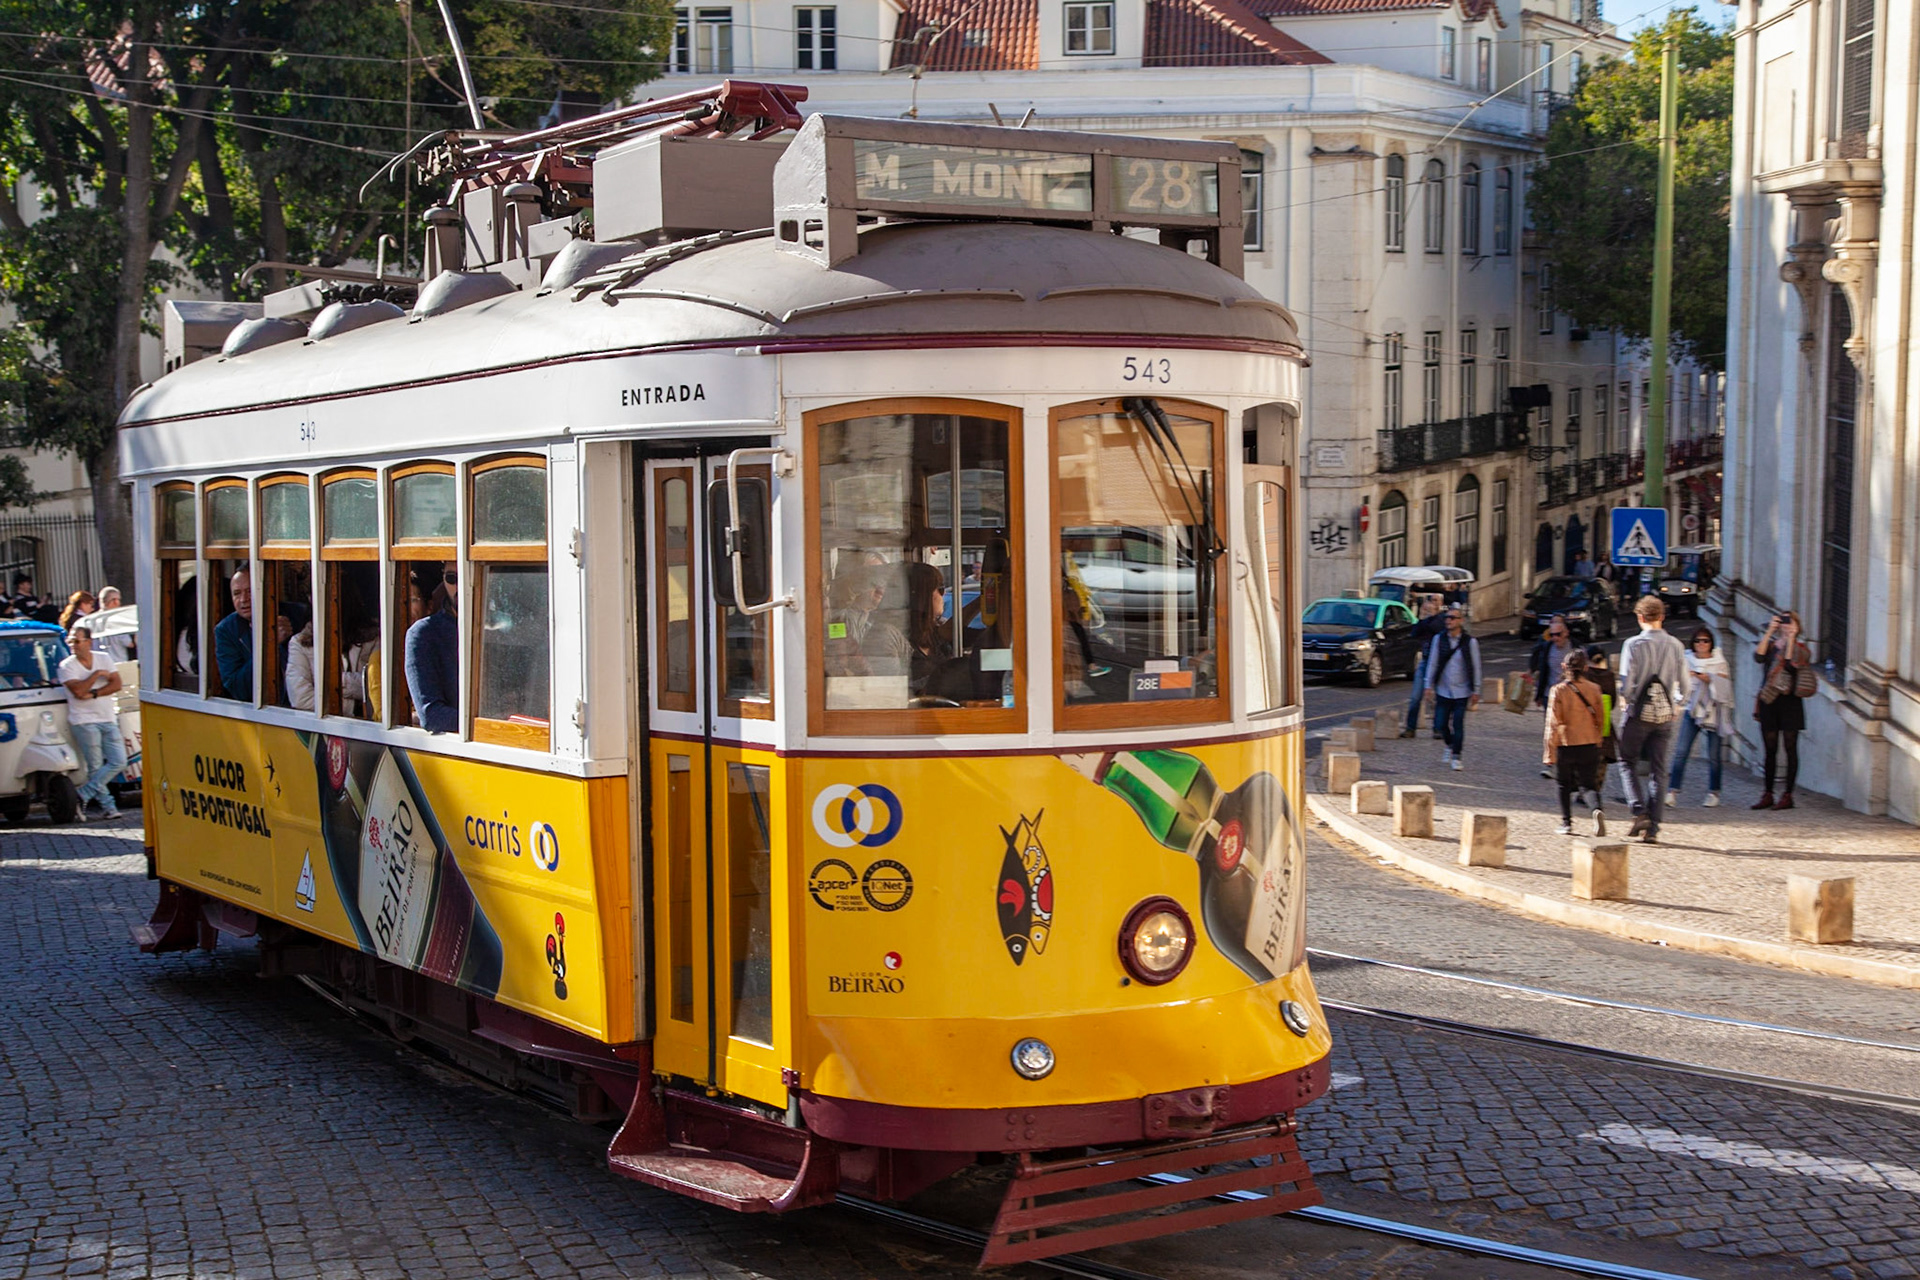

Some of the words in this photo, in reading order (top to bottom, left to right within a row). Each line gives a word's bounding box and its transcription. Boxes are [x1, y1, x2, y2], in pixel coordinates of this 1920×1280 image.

[865, 152, 907, 190] M.
[932, 158, 1075, 205] MONIZ
[1128, 160, 1192, 209] 28
[1123, 356, 1171, 384] 543
[621, 383, 706, 407] ENTRADA
[301, 421, 316, 441] 543
[1136, 677, 1159, 690] 28E
[194, 753, 204, 783] O
[205, 756, 247, 793] LICOR
[180, 788, 199, 819] DE
[198, 793, 272, 839] PORTUGAL
[464, 809, 522, 857] carris
[375, 799, 413, 955] BEIRÃO
[817, 880, 851, 893] apcer
[871, 881, 903, 891] IQNet
[828, 975, 905, 994] BEIRÃO
